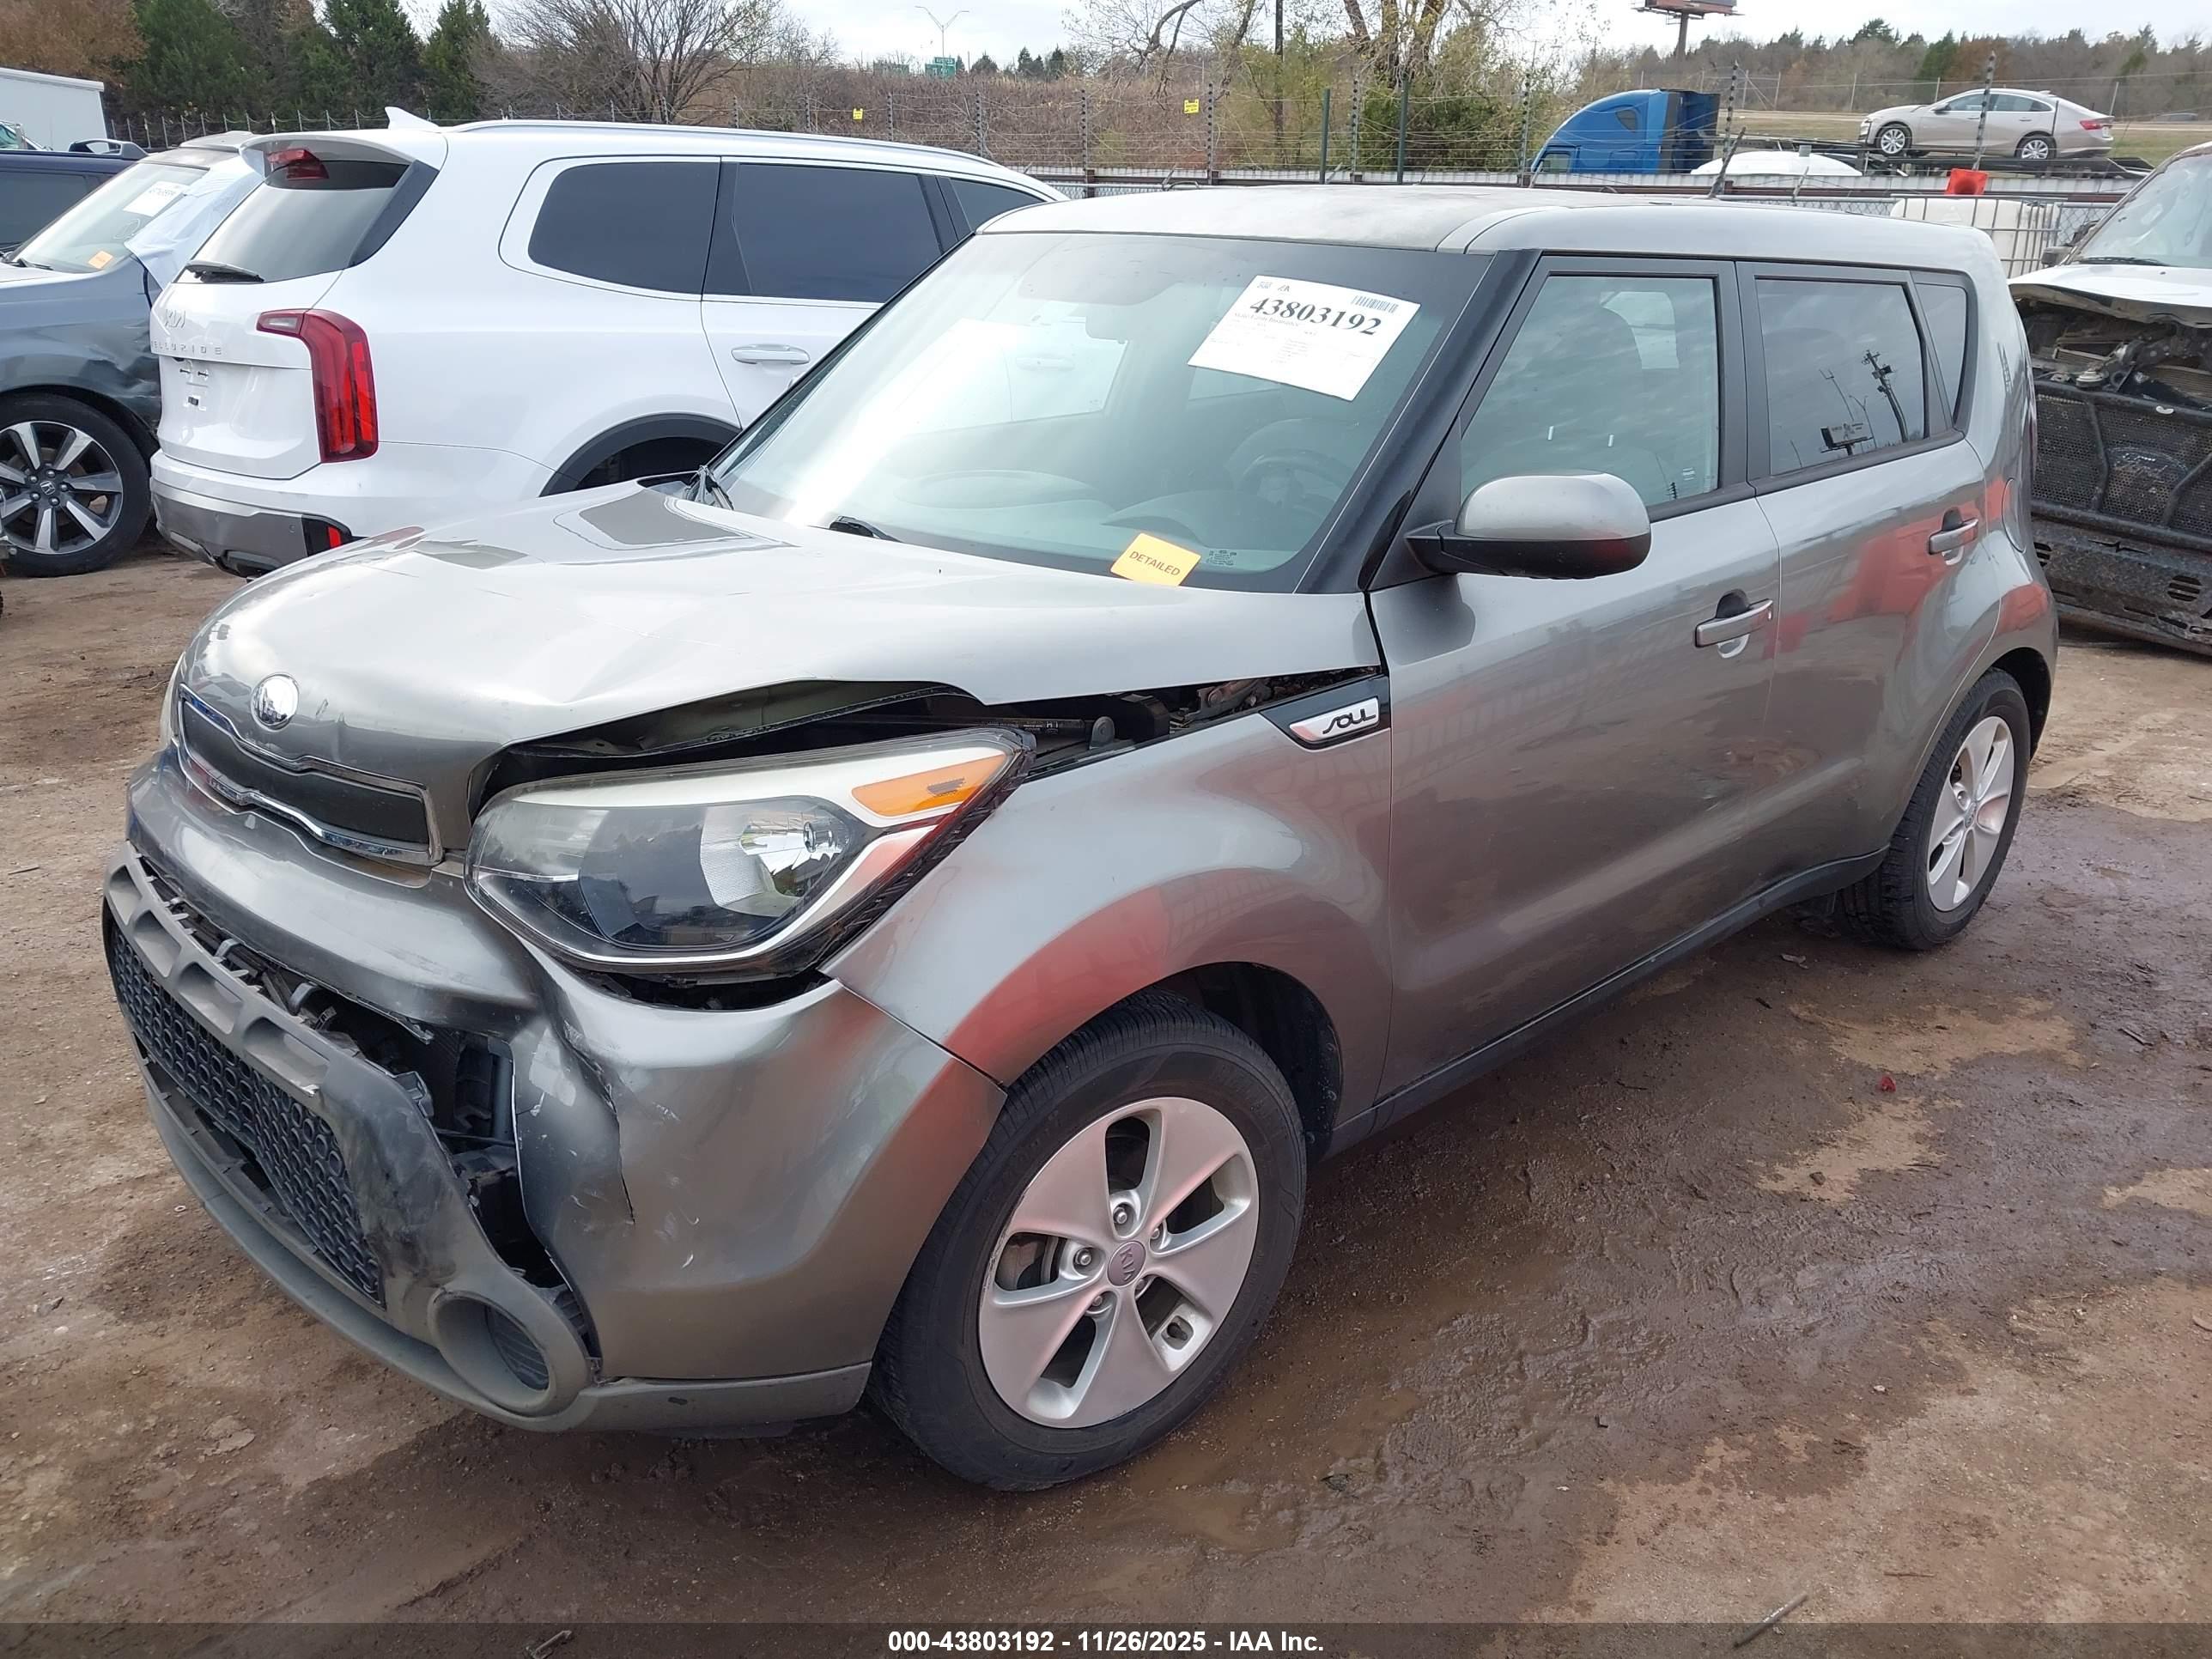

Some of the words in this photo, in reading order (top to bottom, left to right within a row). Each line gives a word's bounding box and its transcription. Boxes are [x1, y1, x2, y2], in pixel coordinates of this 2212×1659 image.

[1249, 296, 1382, 336] 43803192
[1128, 550, 1181, 576] DETAILED
[1119, 1245, 1136, 1282] KIA
